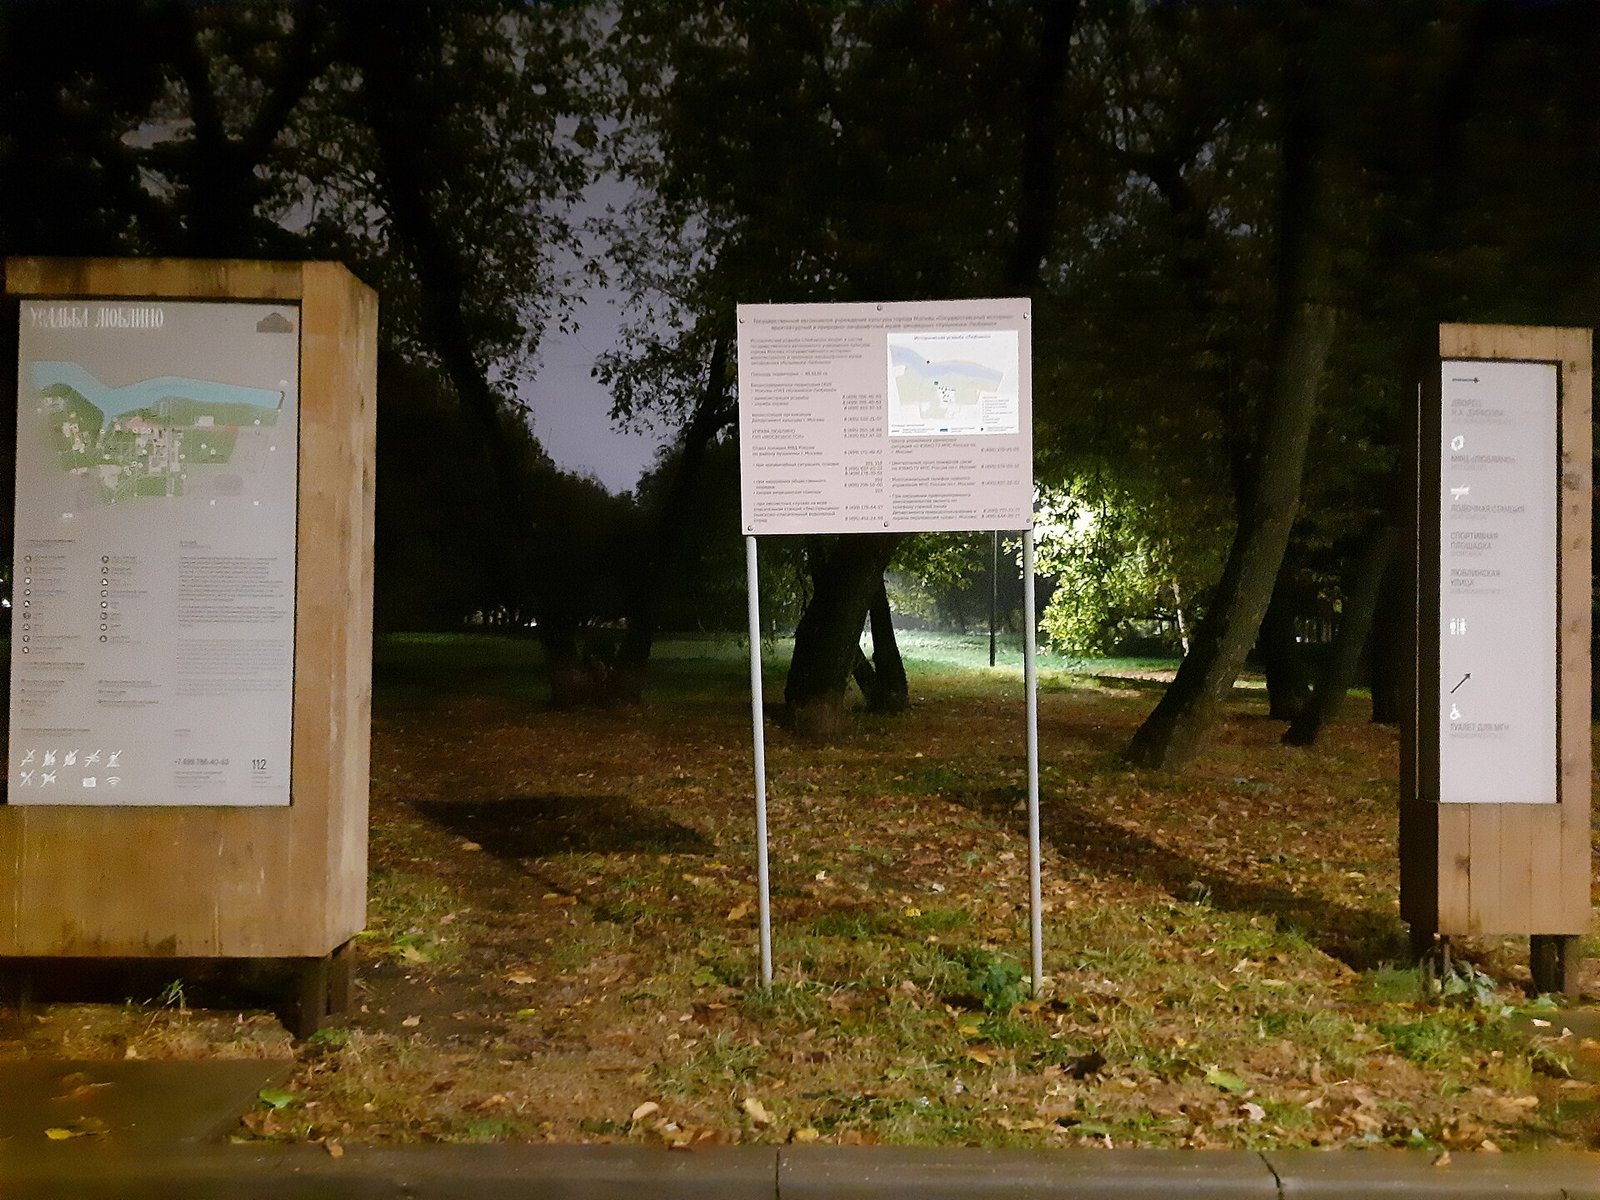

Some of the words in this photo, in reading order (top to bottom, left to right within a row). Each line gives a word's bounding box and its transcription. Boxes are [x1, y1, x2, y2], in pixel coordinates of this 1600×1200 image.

[30, 307, 89, 328] УСАДЬБА
[95, 307, 164, 328] ЛЮБЛИНО
[252, 759, 266, 770] 112
